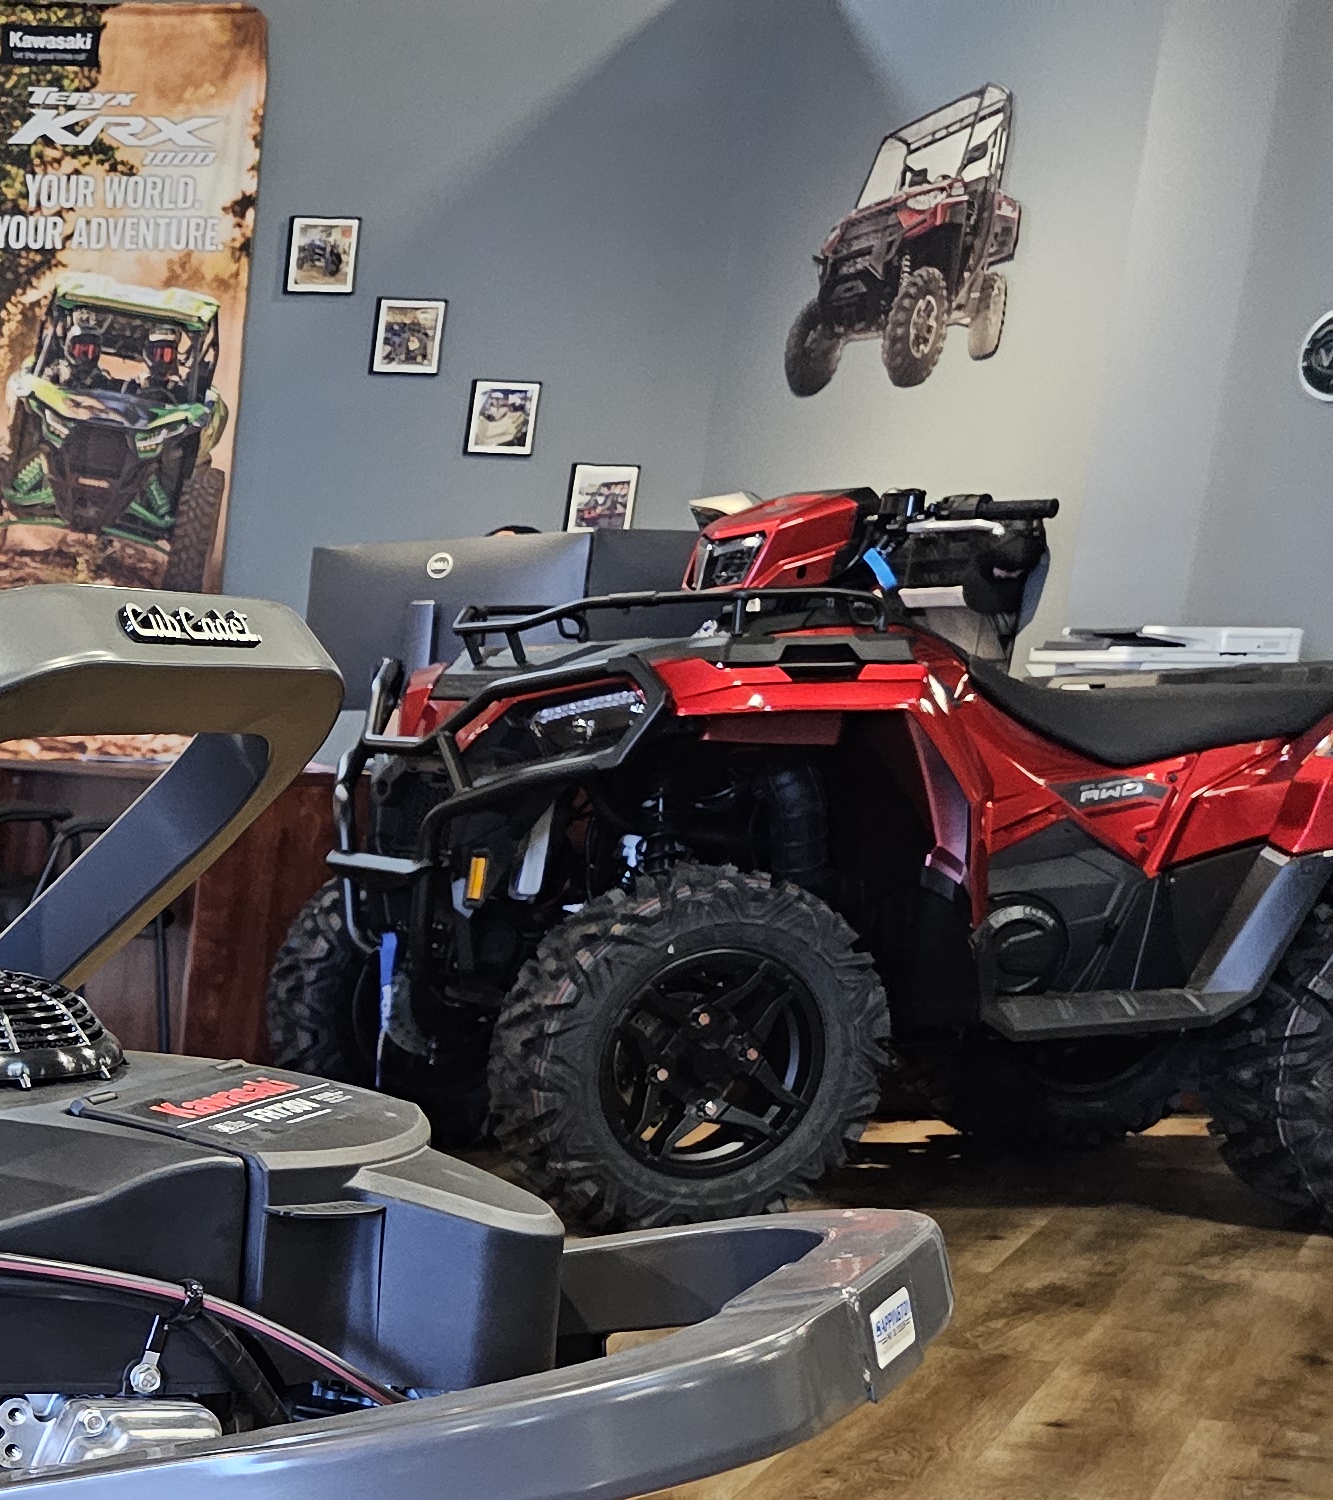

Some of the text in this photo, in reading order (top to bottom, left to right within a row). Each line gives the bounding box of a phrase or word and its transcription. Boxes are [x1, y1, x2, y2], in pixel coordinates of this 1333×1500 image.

[9, 31, 93, 50] Kawasaki
[7, 108, 222, 148] KRX
[143, 151, 217, 168] 1000
[26, 173, 202, 211] YOUR WORLD.
[71, 216, 224, 252] ADVENTURE.
[124, 601, 263, 643] Cub Cadet
[149, 1076, 301, 1119] Kawasaki
